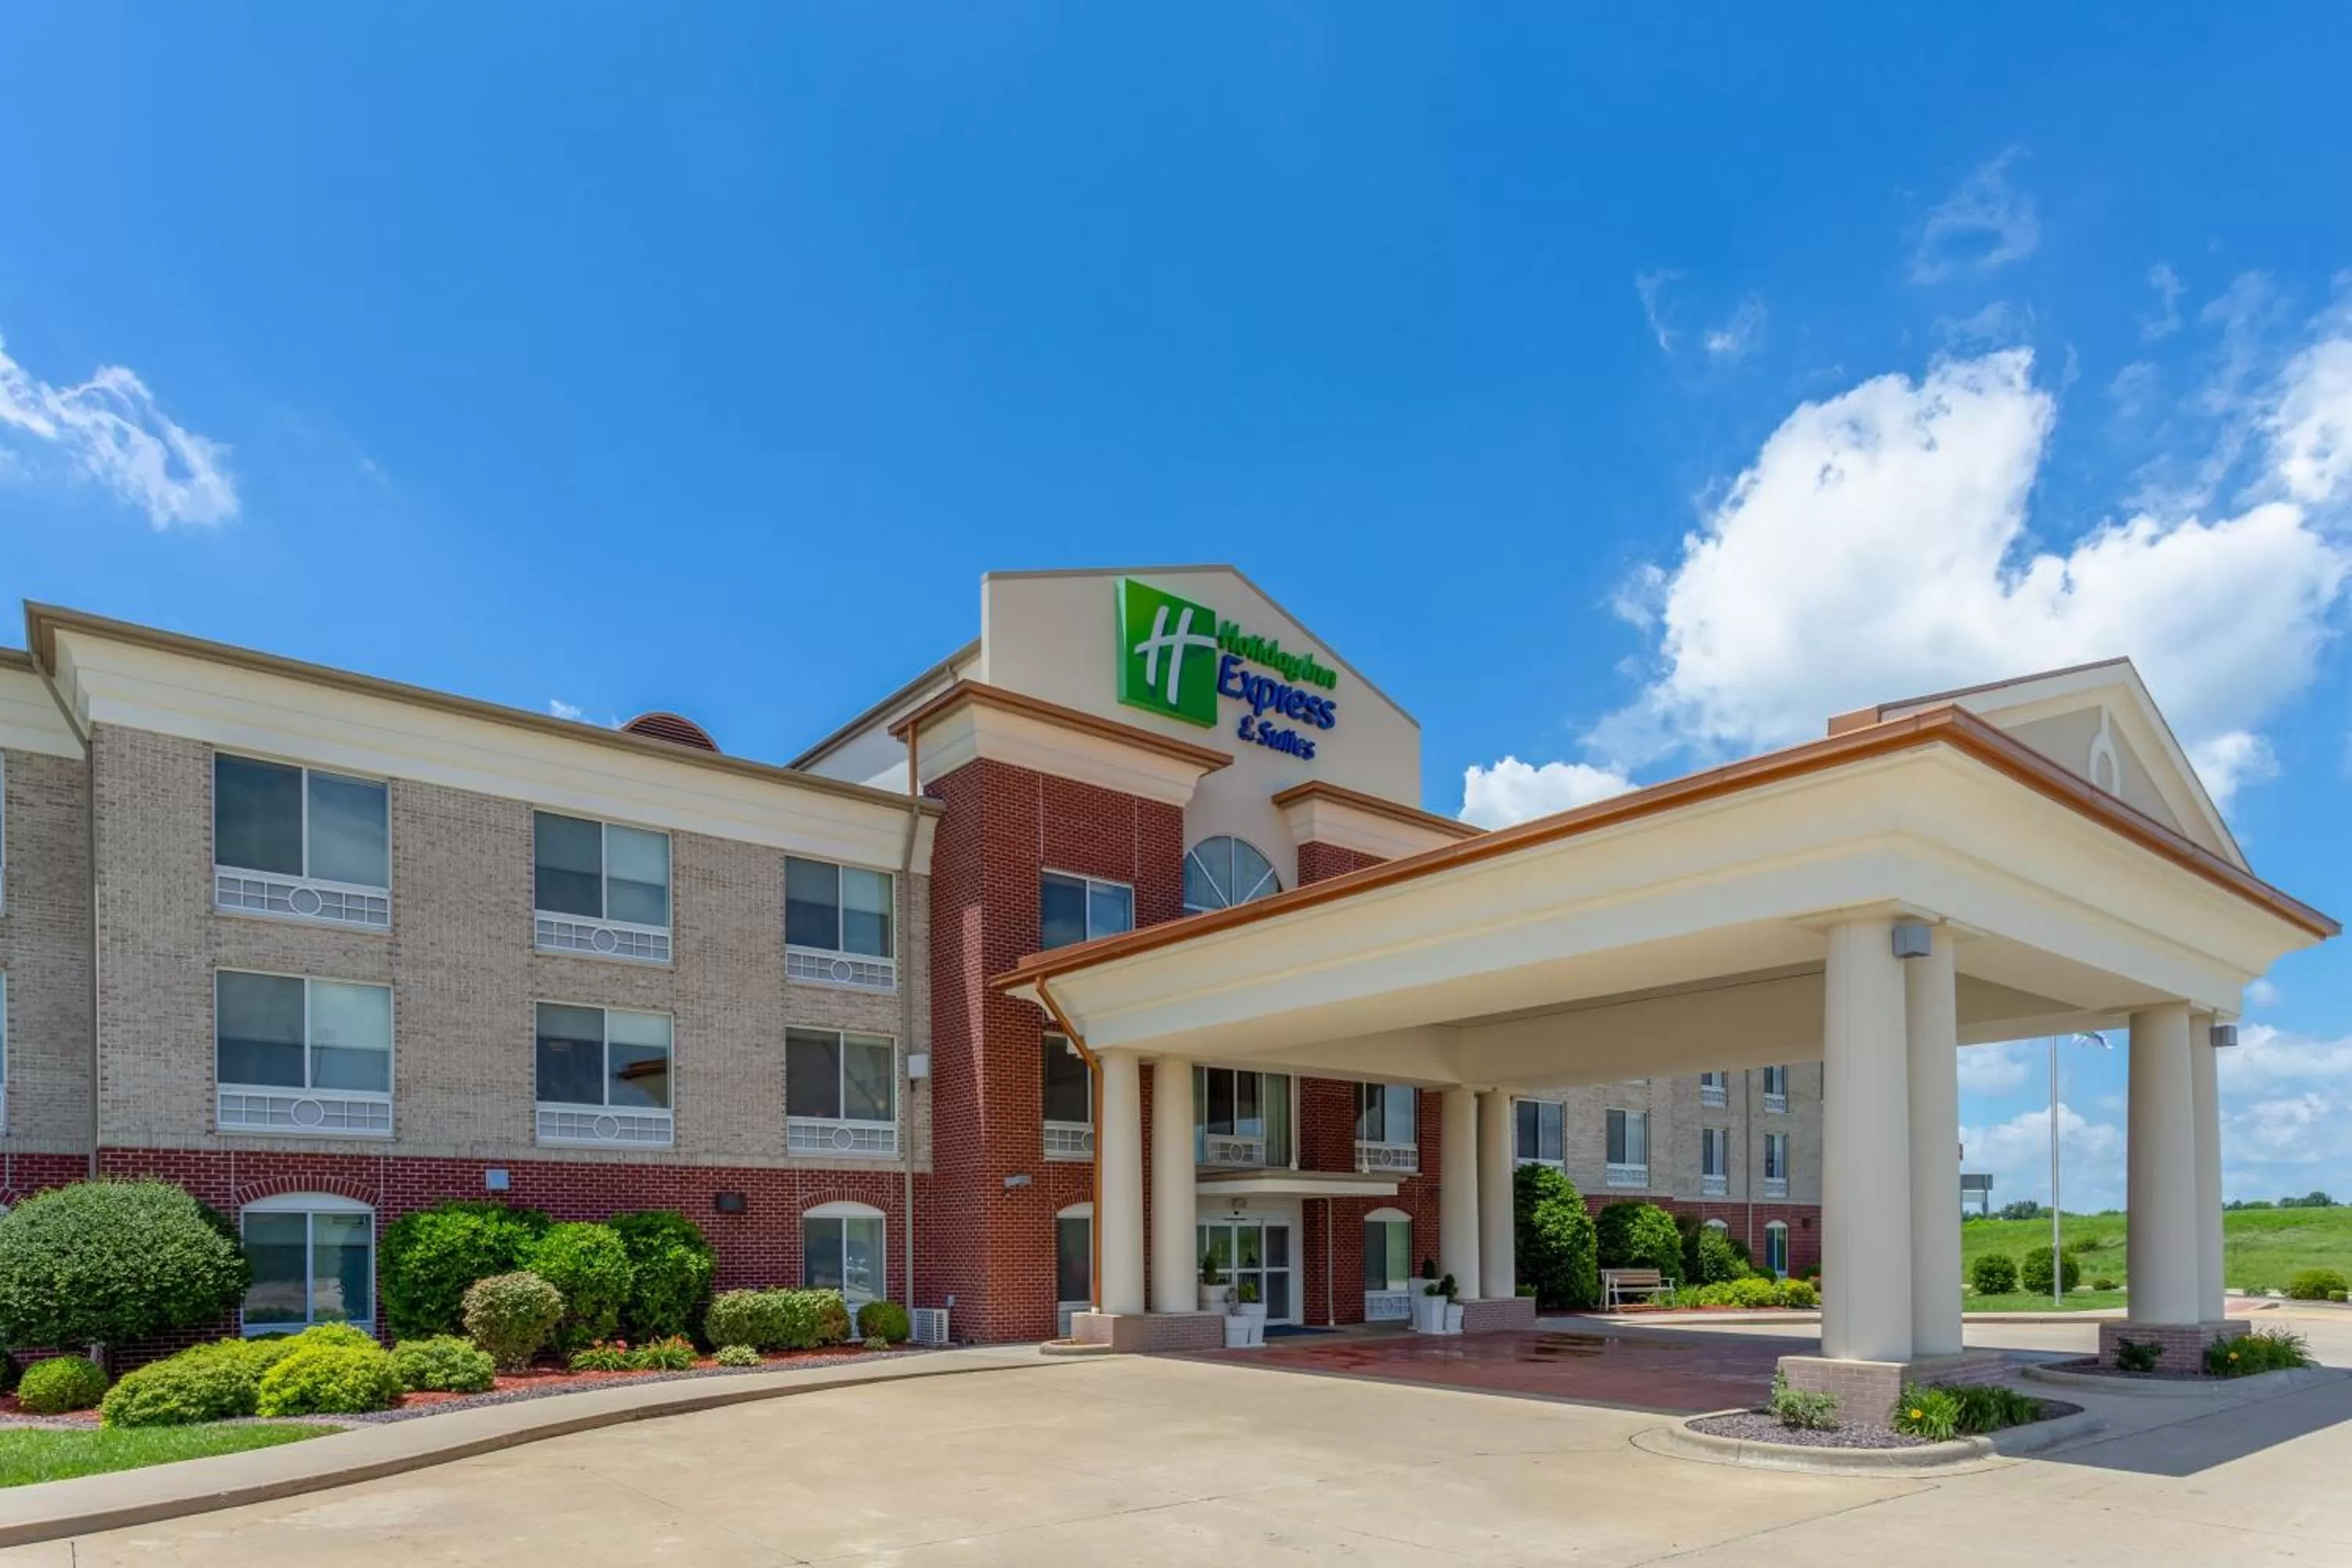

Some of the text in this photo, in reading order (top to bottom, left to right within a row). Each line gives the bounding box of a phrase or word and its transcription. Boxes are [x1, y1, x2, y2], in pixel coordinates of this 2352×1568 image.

[1218, 654, 1337, 730] Express
[1237, 714, 1316, 760] & Suites
